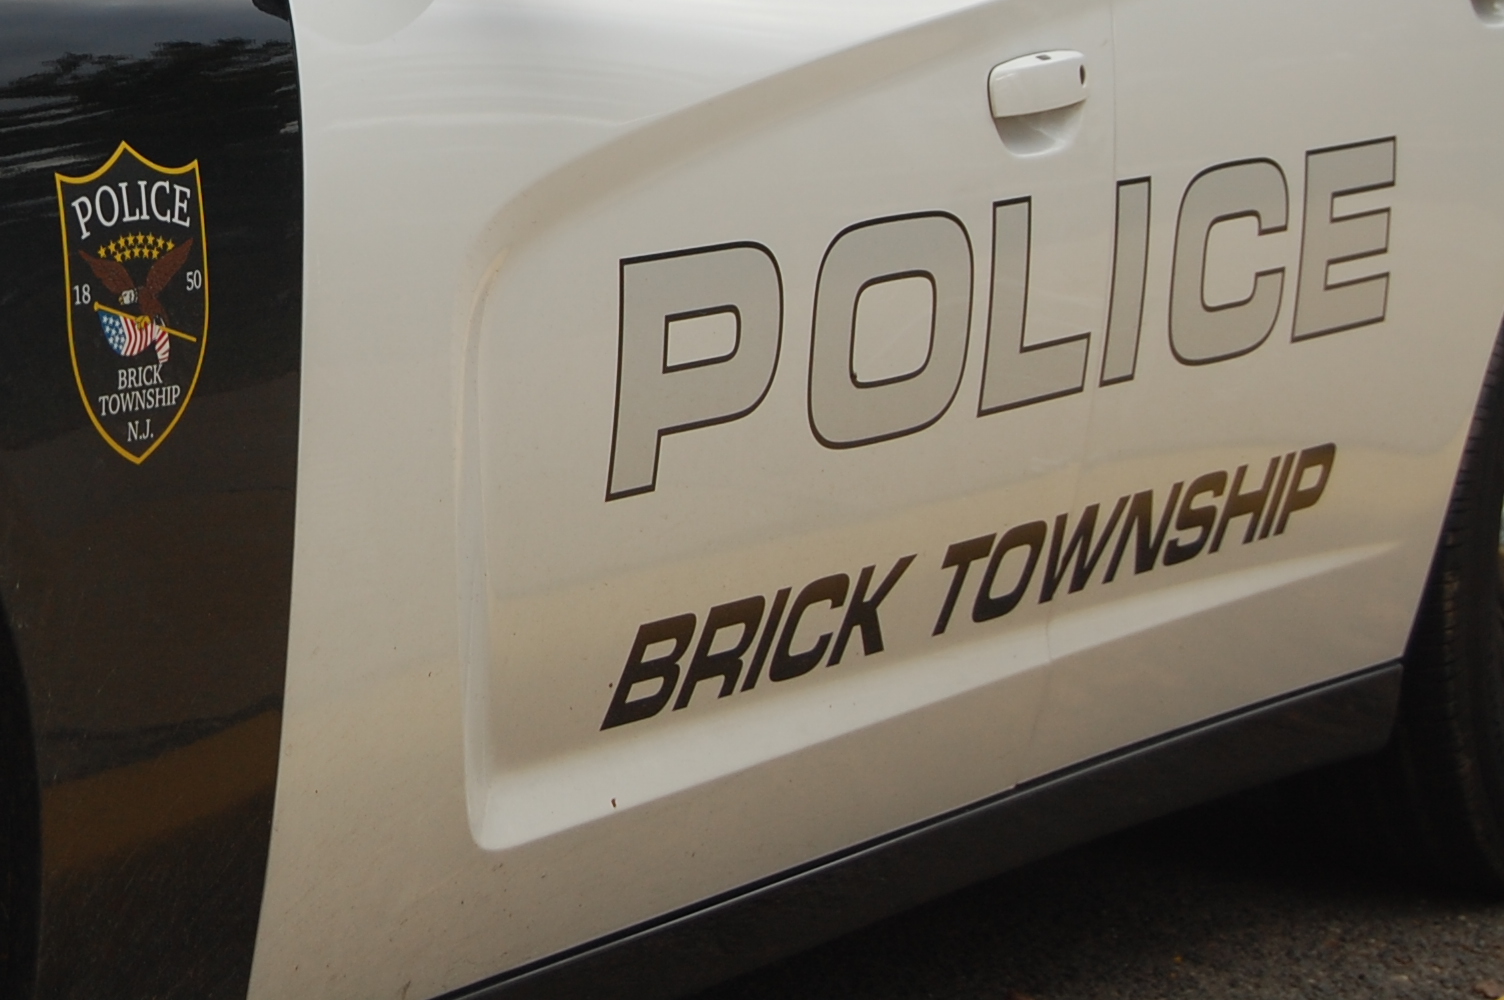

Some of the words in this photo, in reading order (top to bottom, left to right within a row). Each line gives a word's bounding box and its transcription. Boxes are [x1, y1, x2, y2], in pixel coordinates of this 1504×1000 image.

[71, 180, 191, 240] POLICE
[73, 283, 91, 305] 18
[186, 269, 202, 291] 50
[605, 136, 1397, 501] POLICE
[117, 363, 163, 391] BRICK
[98, 384, 181, 417] TOWNSHIP
[127, 419, 154, 442] N.J.
[600, 554, 917, 730] BRICK
[932, 442, 1337, 636] TOWNSHIP
